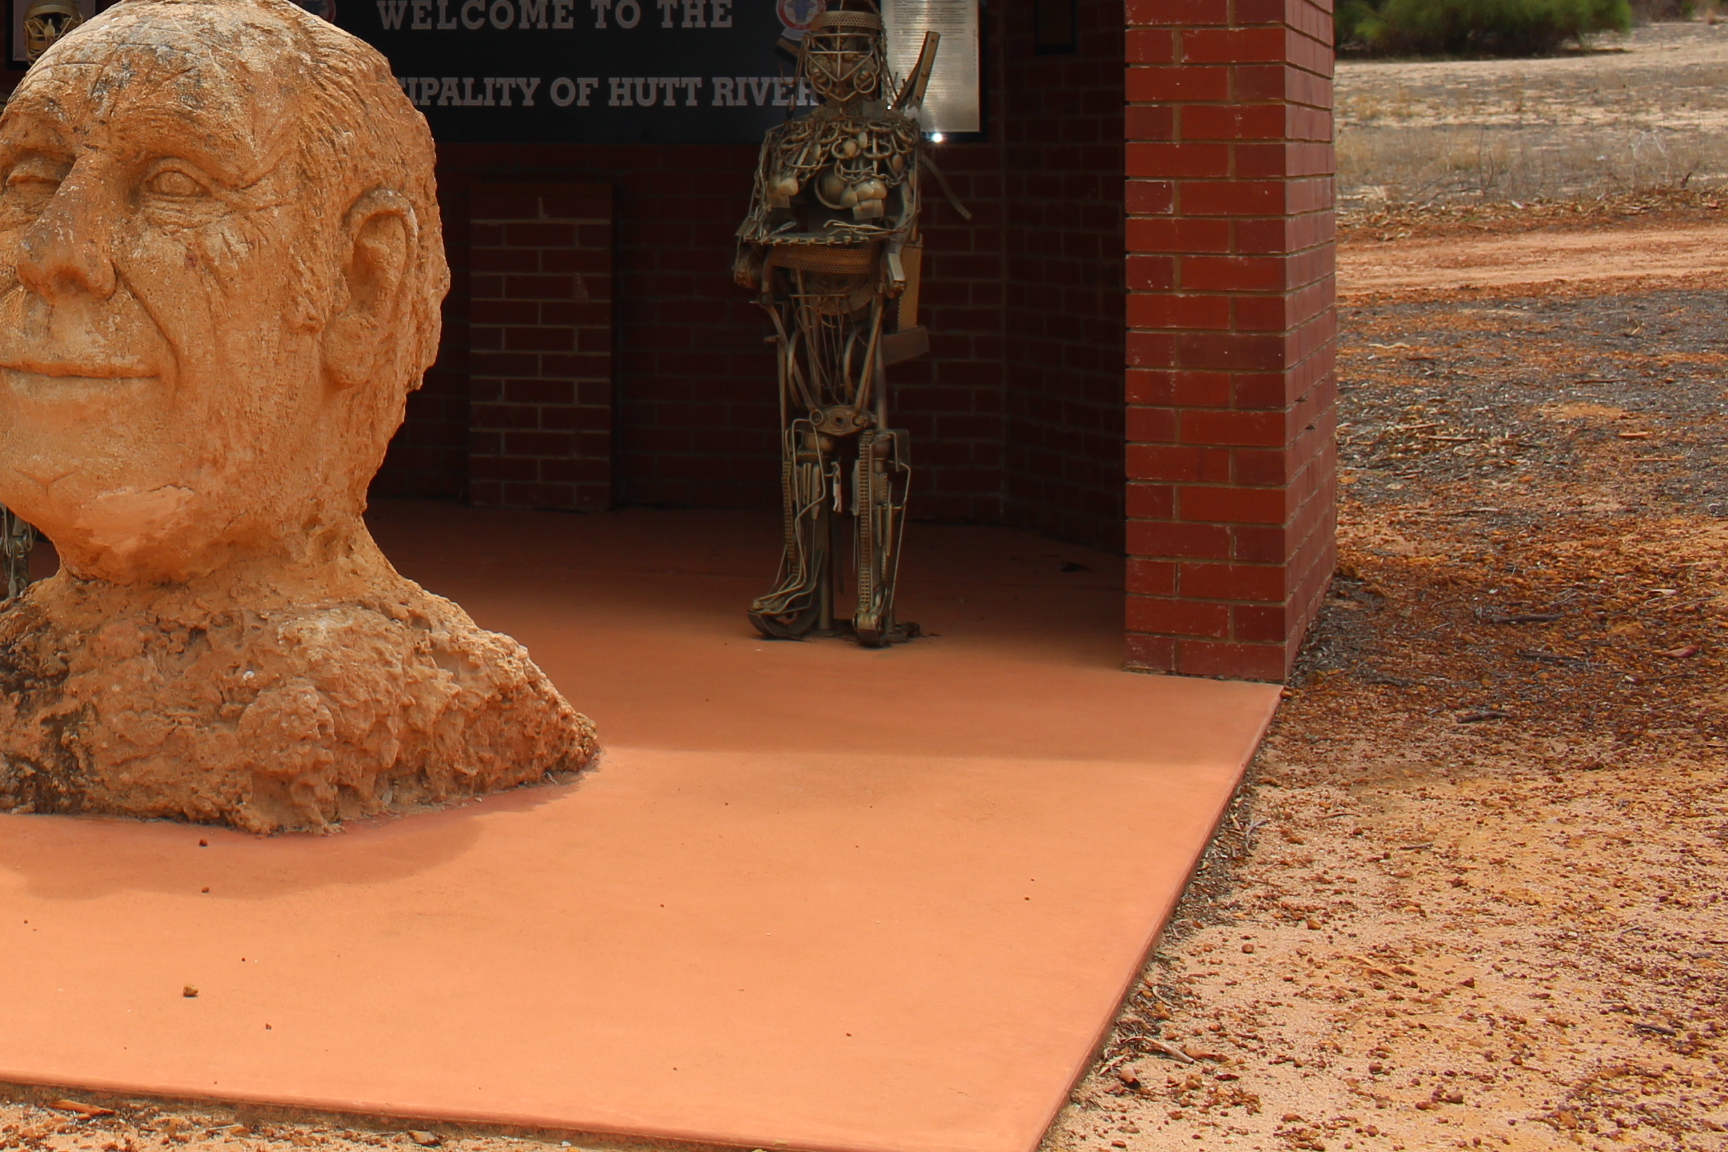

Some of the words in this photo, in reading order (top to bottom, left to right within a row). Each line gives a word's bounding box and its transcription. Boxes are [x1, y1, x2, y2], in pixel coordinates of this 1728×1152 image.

[397, 76, 541, 107] IPALITY
[549, 76, 599, 107] OF
[608, 76, 703, 107] HUTT
[711, 76, 820, 107] RIVER
